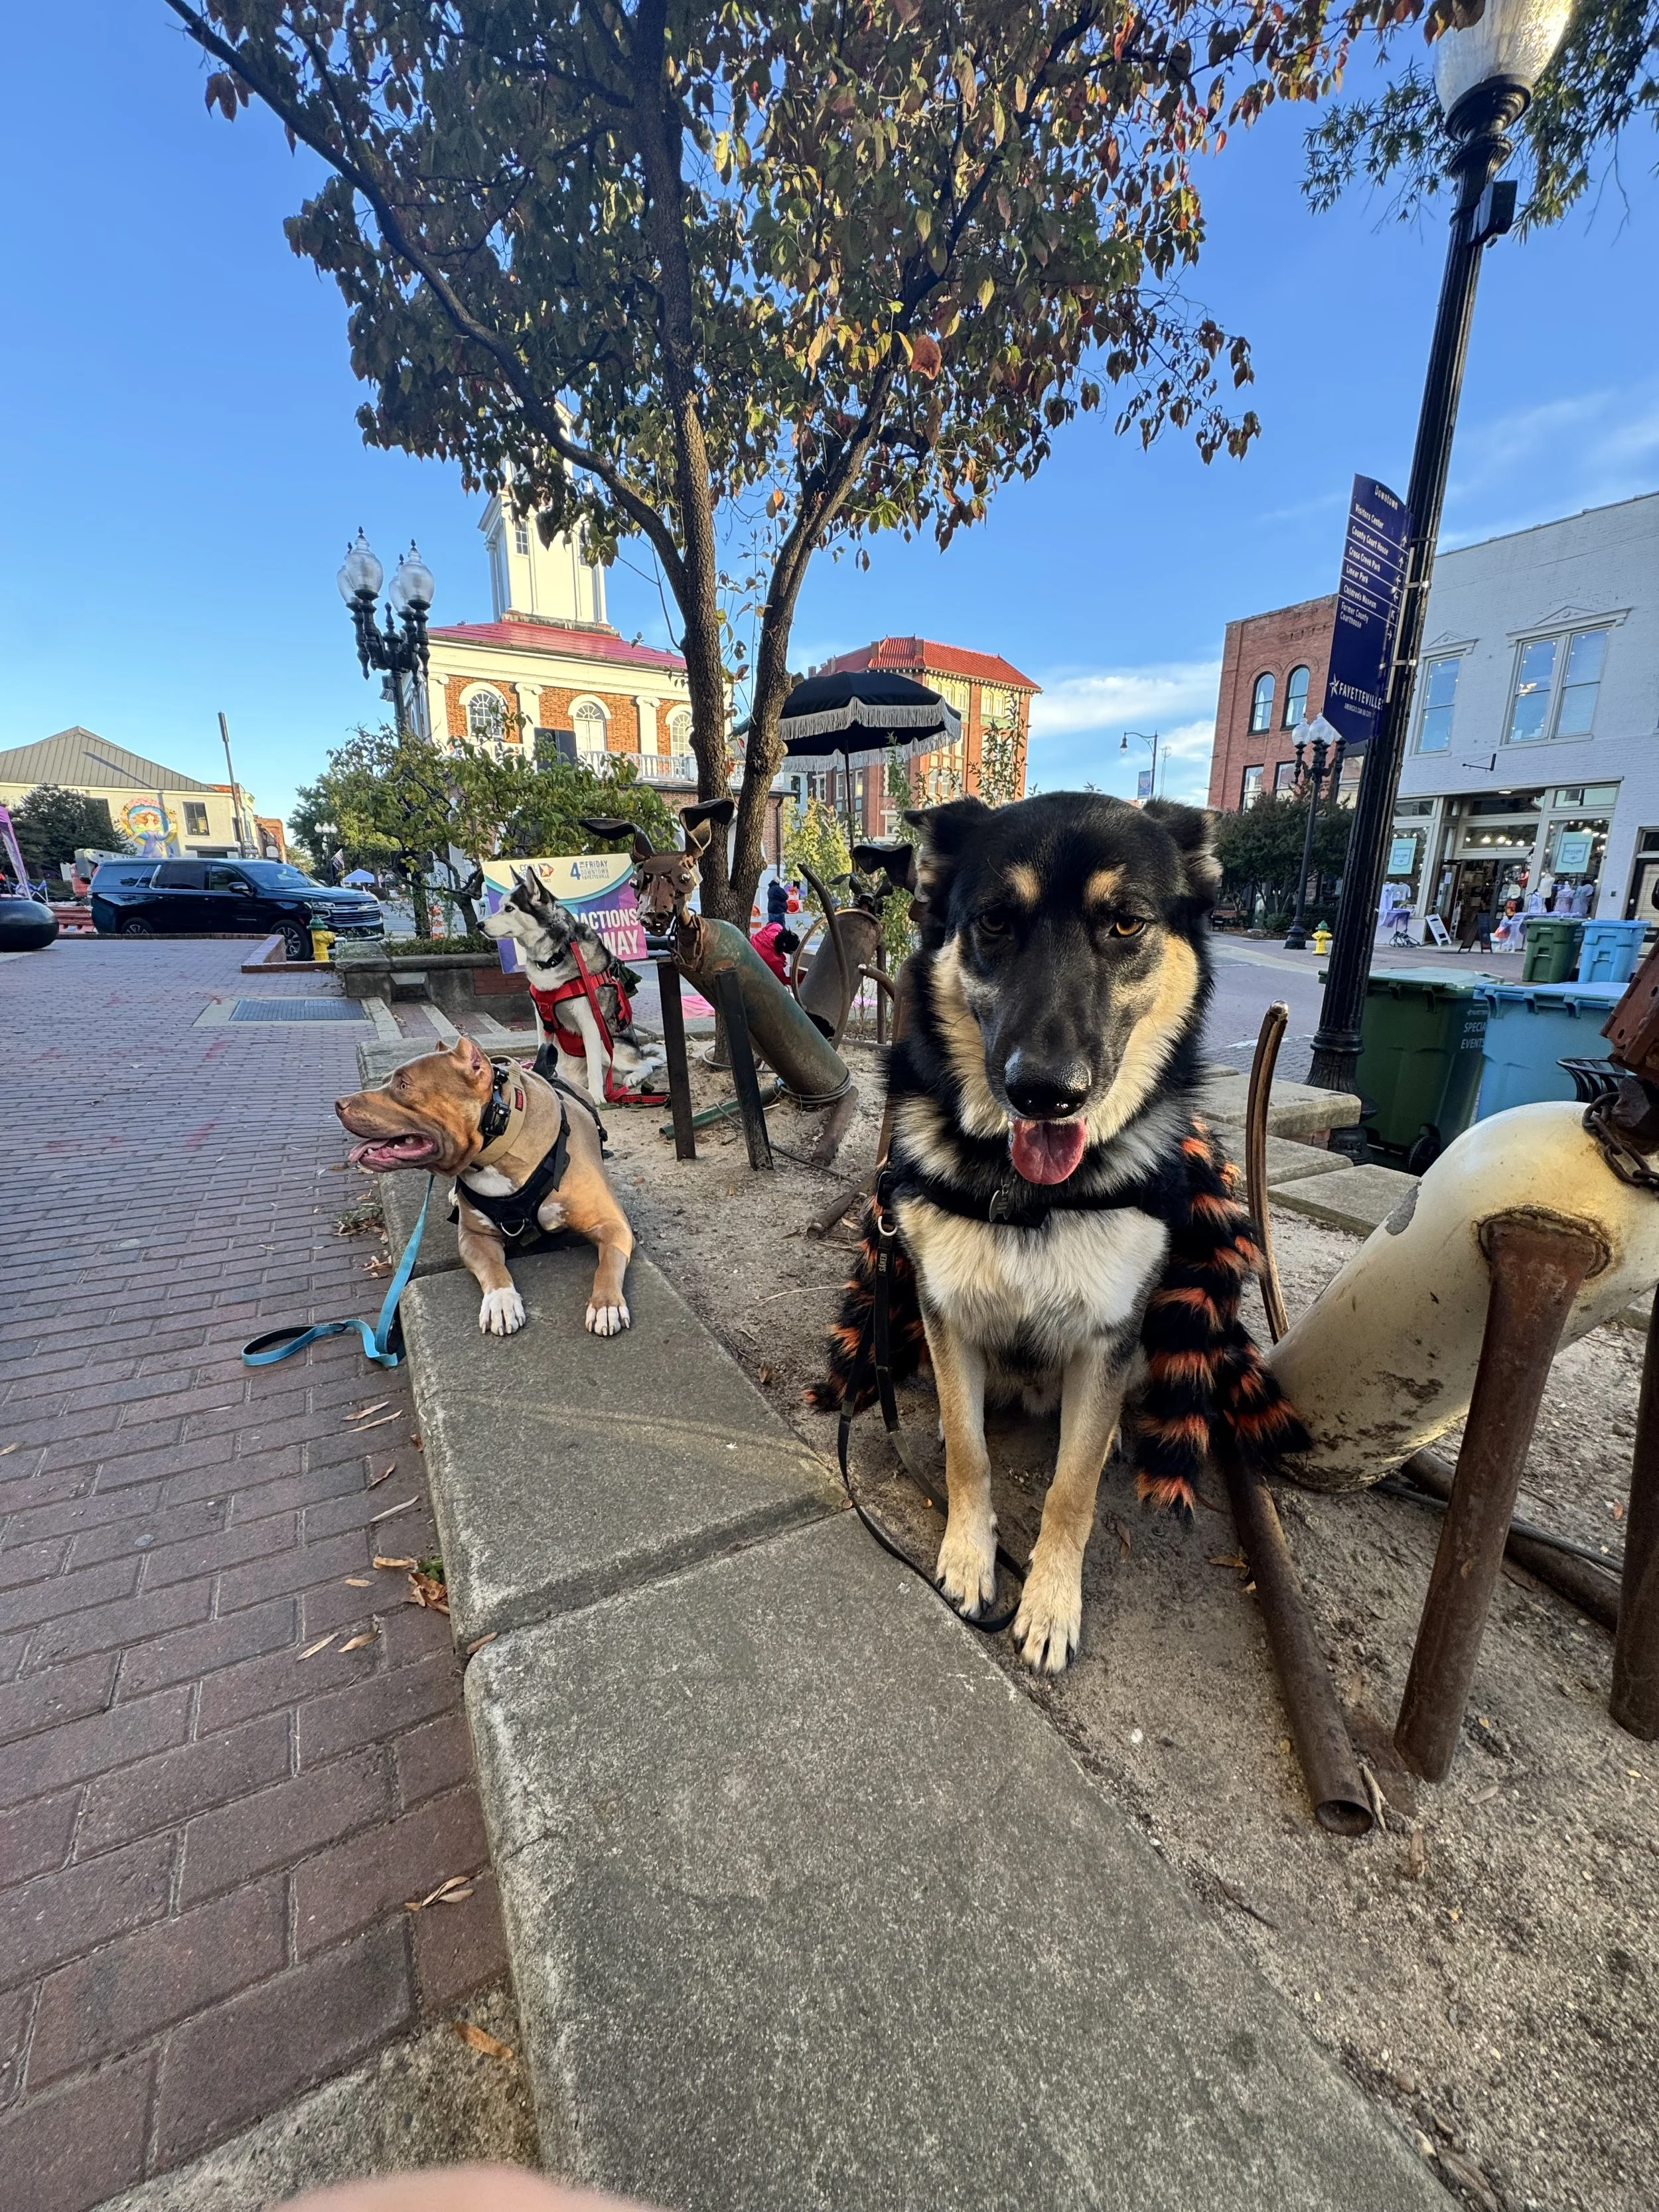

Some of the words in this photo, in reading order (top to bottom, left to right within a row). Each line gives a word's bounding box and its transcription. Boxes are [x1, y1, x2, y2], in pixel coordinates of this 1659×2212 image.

[1374, 485, 1398, 510] Downtown
[1355, 503, 1371, 521] Visitors
[1371, 514, 1384, 529] Center
[1352, 526, 1366, 543] County
[1366, 535, 1378, 549] Court
[1377, 542, 1389, 555] House
[1348, 546, 1360, 559] Cross
[1360, 553, 1372, 567] Creek
[1372, 559, 1380, 572] Park
[1346, 564, 1359, 578] Linear
[1359, 572, 1368, 584] Park
[1343, 584, 1362, 601] Children's
[1362, 595, 1377, 609] Museum
[1340, 611, 1362, 628] Courthouse
[1341, 601, 1355, 615] Former
[1355, 609, 1369, 624] County
[585, 860, 607, 869] FRIDAY
[1463, 1021, 1486, 1033] SPECIA
[1461, 1038, 1484, 1049] EVENT
